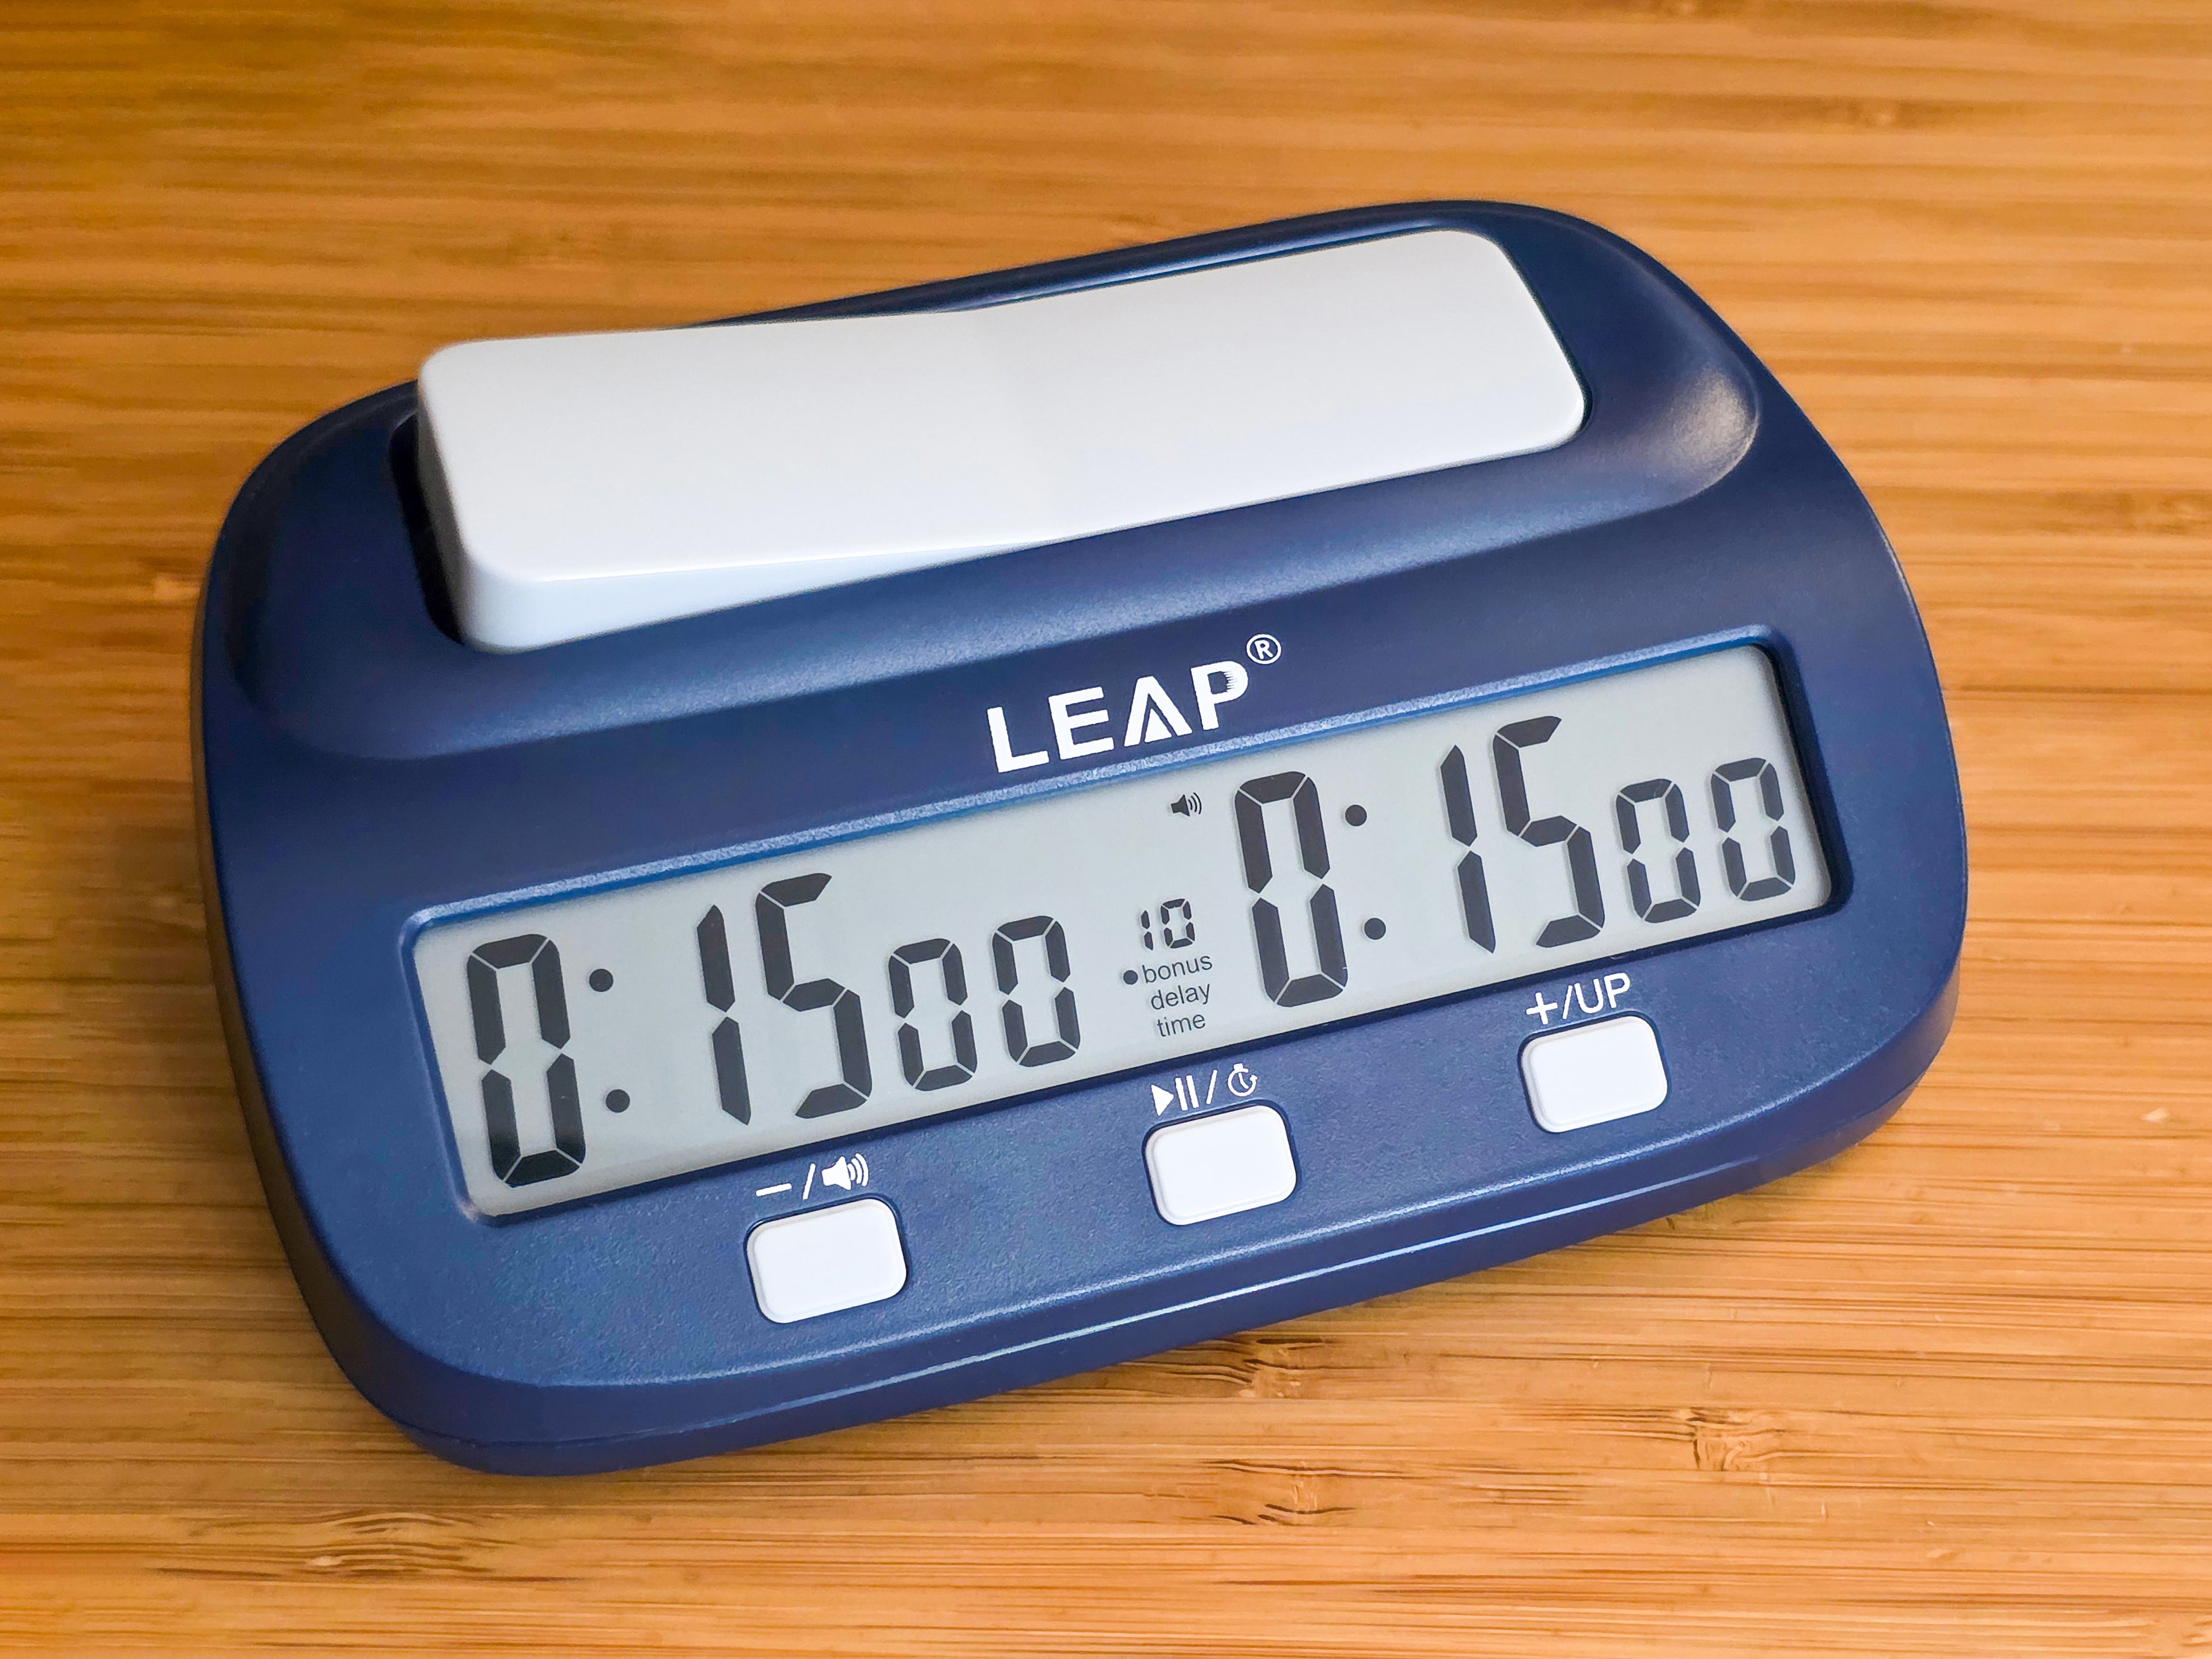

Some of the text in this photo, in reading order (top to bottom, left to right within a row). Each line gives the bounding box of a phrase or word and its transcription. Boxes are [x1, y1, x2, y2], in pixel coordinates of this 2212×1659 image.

[1141, 898, 1195, 950] 10
[1142, 955, 1213, 984] bonus
[1150, 983, 1211, 1010] delay
[1156, 1013, 1206, 1037] time
